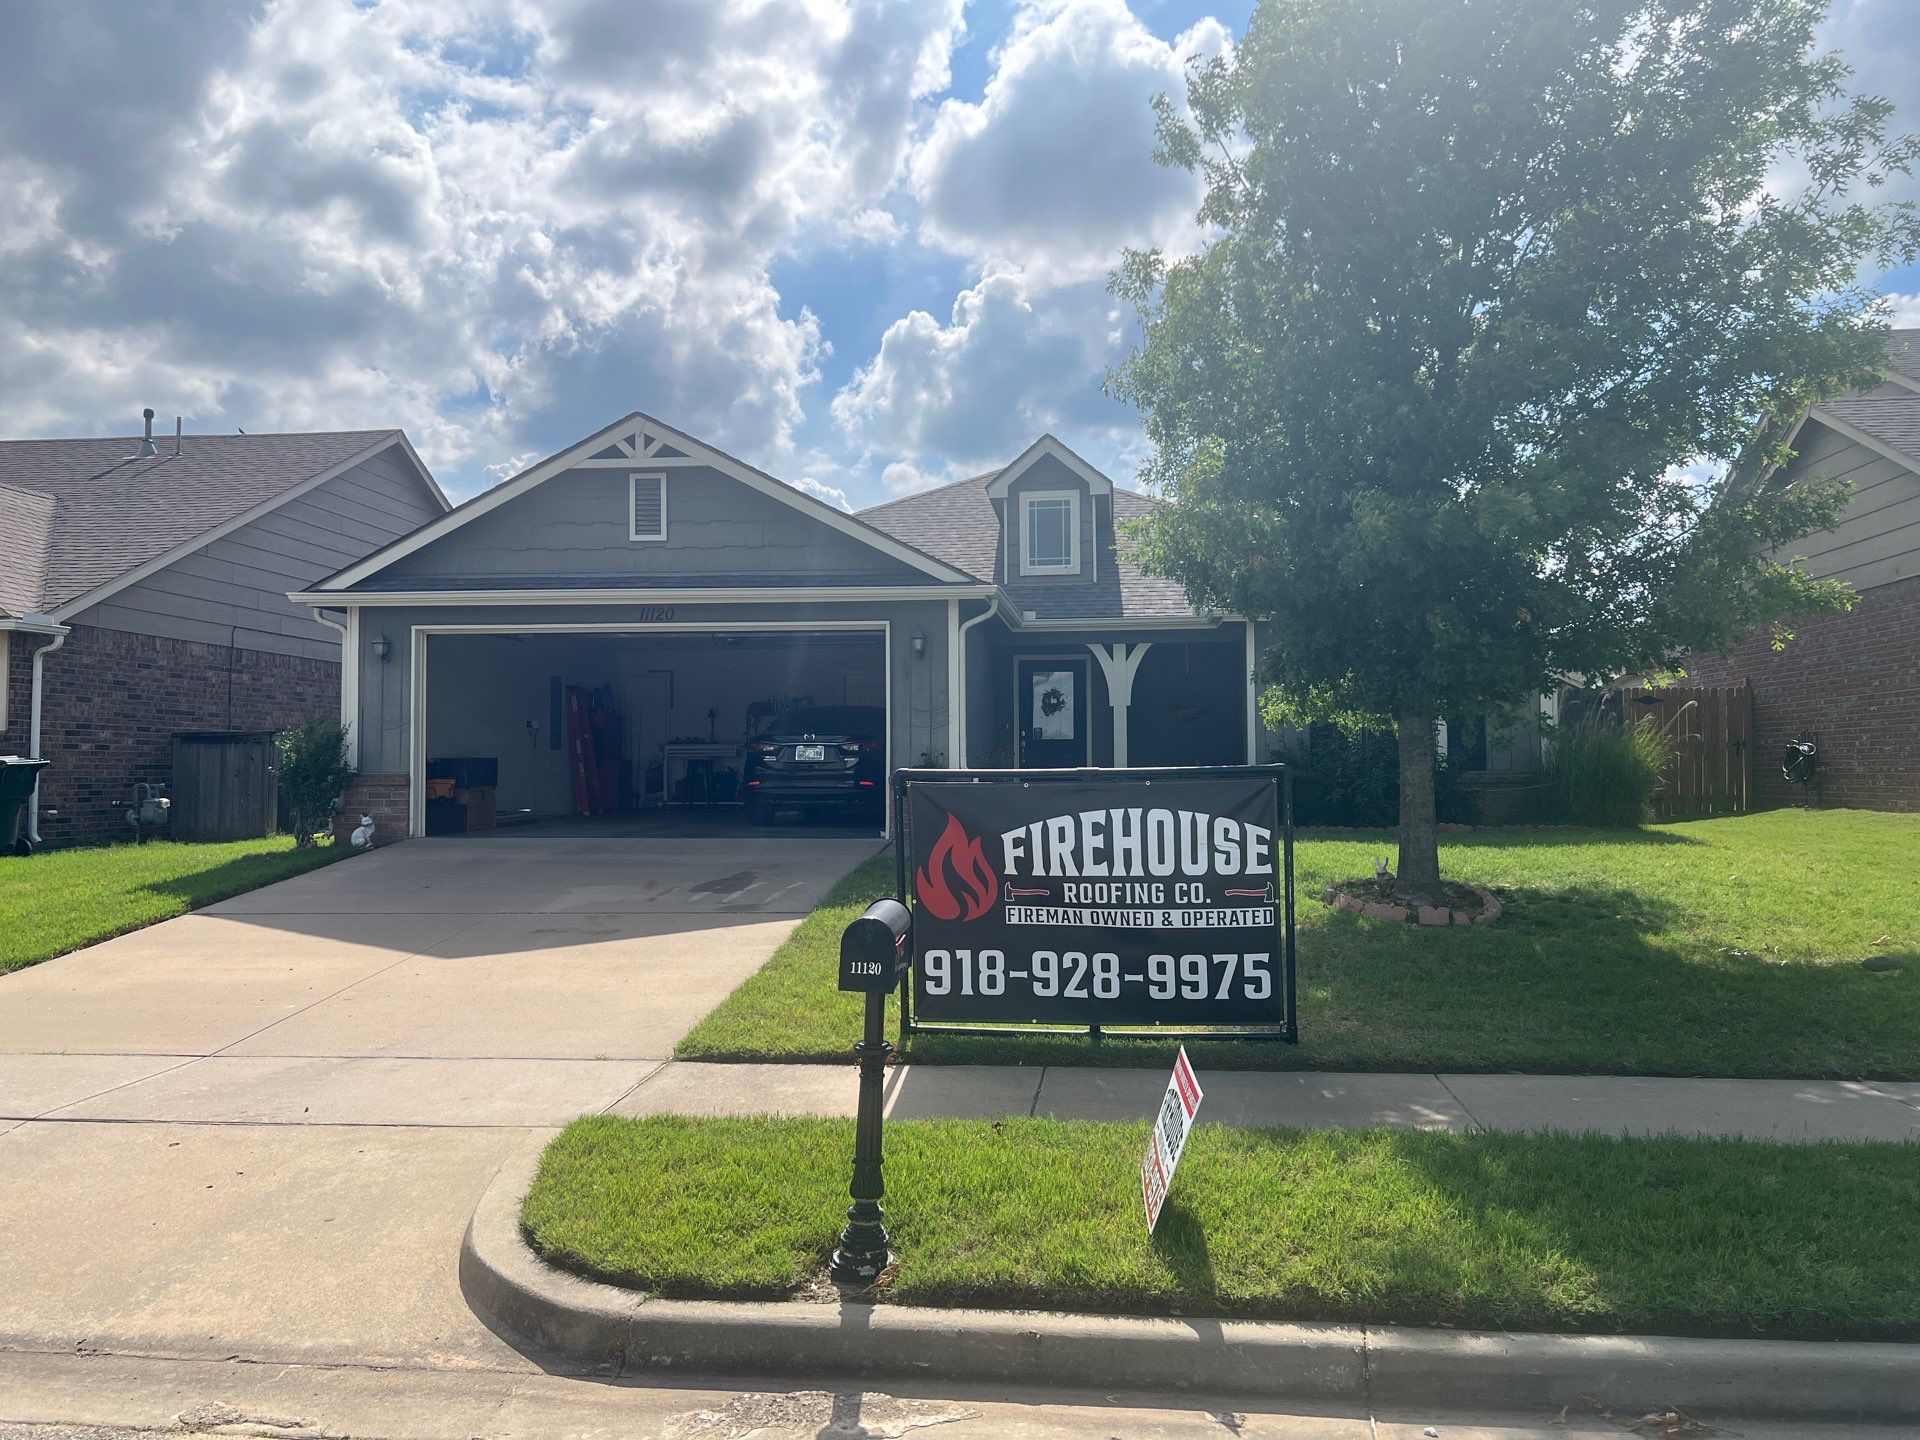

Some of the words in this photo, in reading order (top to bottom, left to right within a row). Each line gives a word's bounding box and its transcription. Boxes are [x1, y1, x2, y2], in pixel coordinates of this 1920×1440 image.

[640, 606, 675, 621] 11120
[1001, 808, 1273, 877] FIREHOUSE
[1063, 882, 1169, 904] ROOFING
[1174, 882, 1212, 904] CO.
[1006, 907, 1084, 925] FIREMAN
[1090, 910, 1155, 927] OWNED
[1161, 911, 1175, 927] &
[1181, 908, 1274, 927] OPERATED
[850, 961, 882, 975] 11120
[924, 949, 1272, 1000] 918-928-9975
